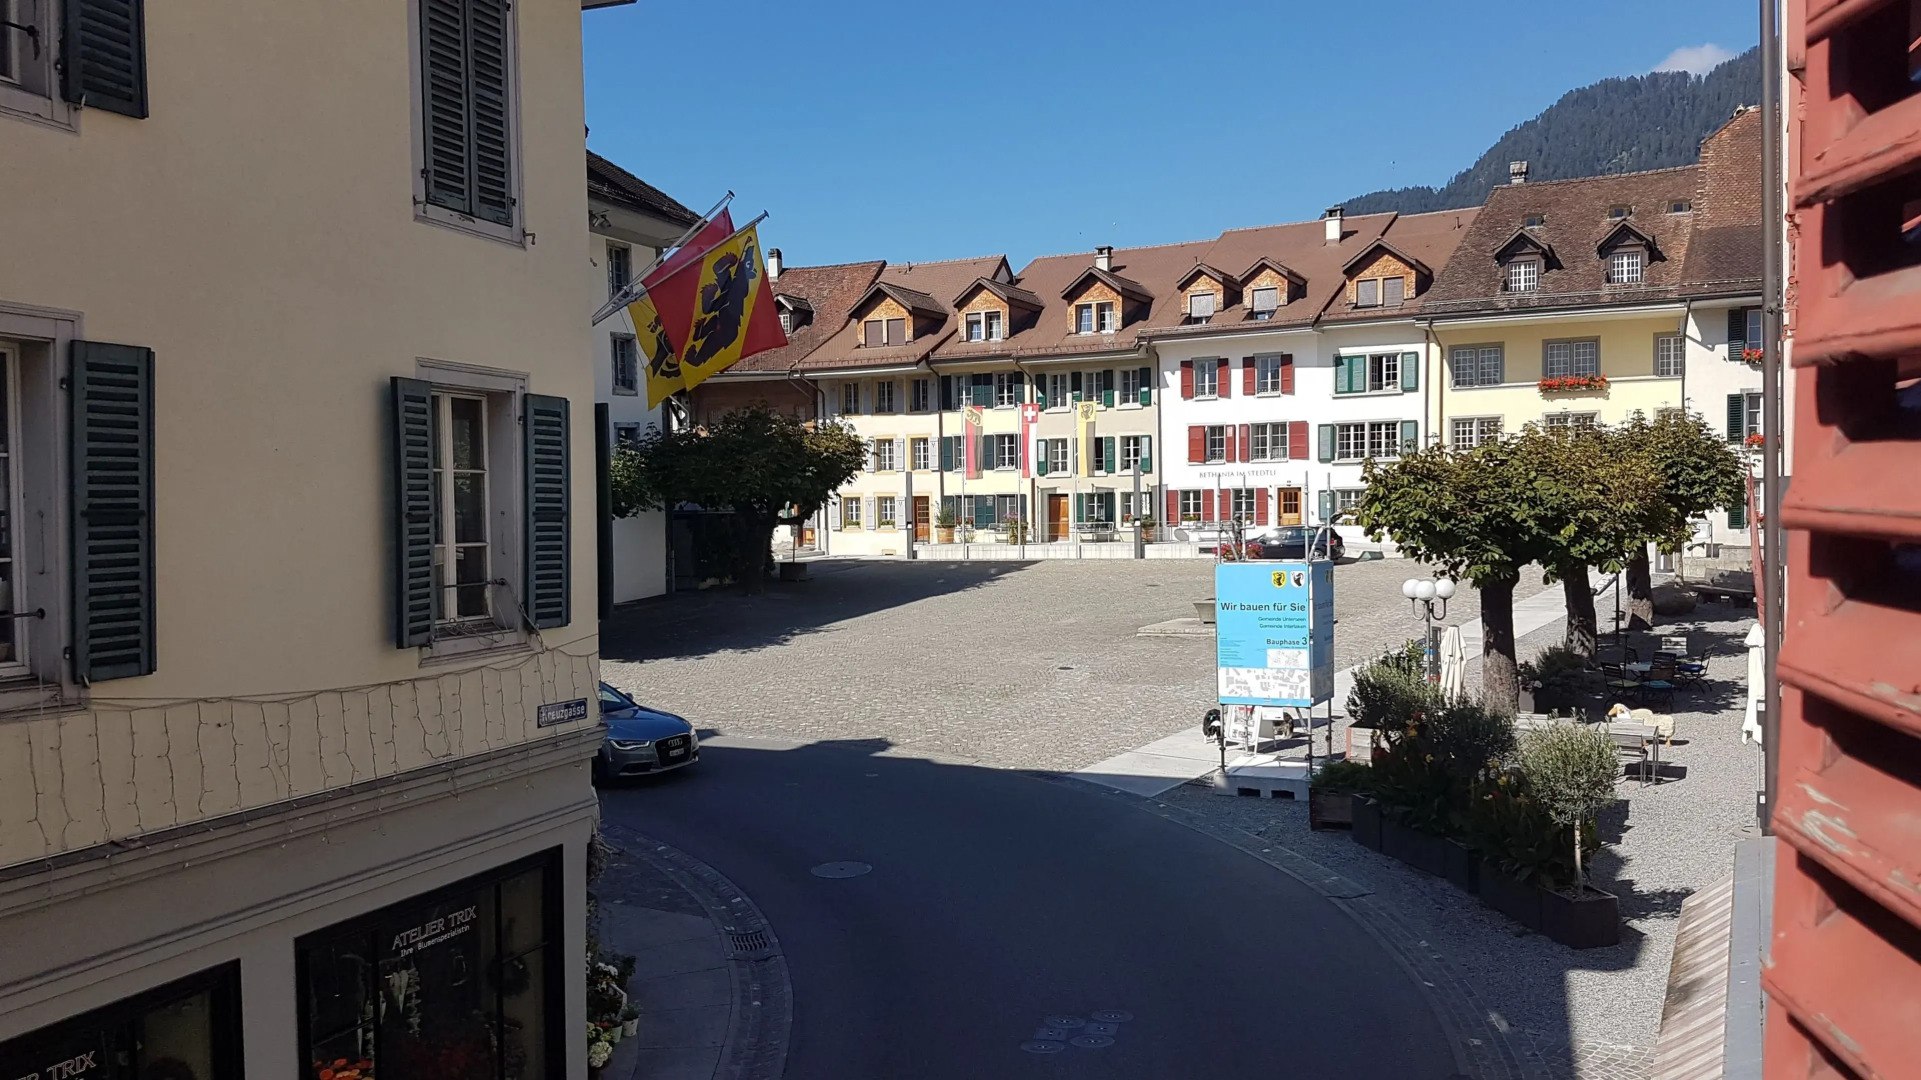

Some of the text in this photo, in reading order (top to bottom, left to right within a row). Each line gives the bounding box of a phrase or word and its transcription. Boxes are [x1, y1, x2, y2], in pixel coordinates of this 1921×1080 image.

[1220, 602, 1237, 611] Wir
[1239, 602, 1270, 611] bauen
[1273, 602, 1287, 611] für
[1290, 602, 1306, 611] Sie
[1266, 636, 1308, 647] Bauphase 3
[541, 705, 585, 721] Kreuzgasse
[392, 905, 477, 950] ATELIER TRIX
[46, 1050, 97, 1080] TRIX
